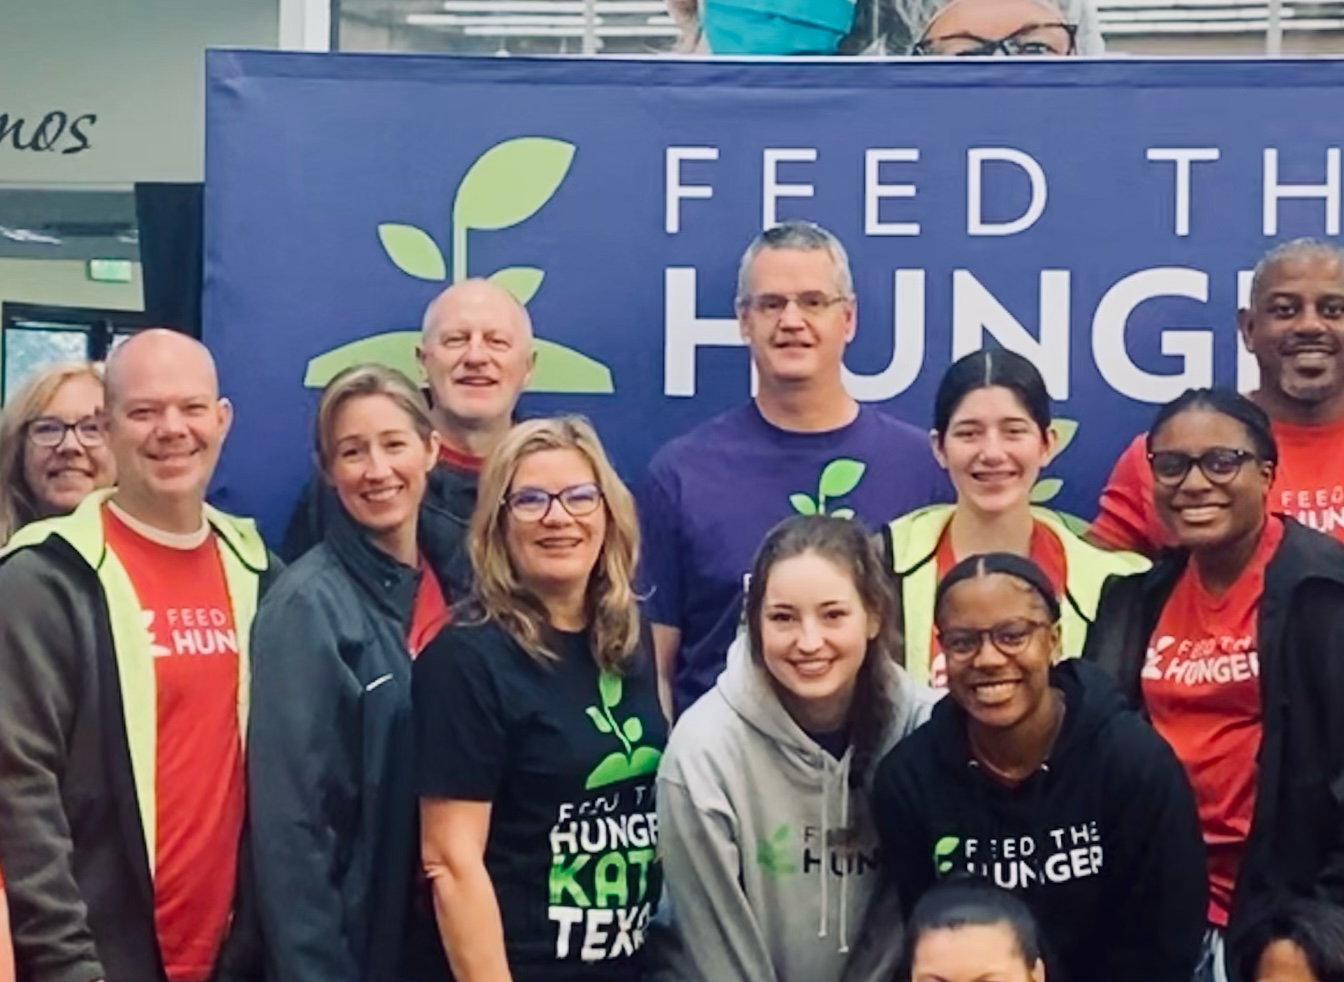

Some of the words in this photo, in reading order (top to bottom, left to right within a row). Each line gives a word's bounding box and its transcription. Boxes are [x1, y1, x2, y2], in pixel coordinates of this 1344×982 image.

[665, 147, 1048, 236] FEED
[1281, 485, 1344, 509] FEED
[166, 608, 227, 627] FEED
